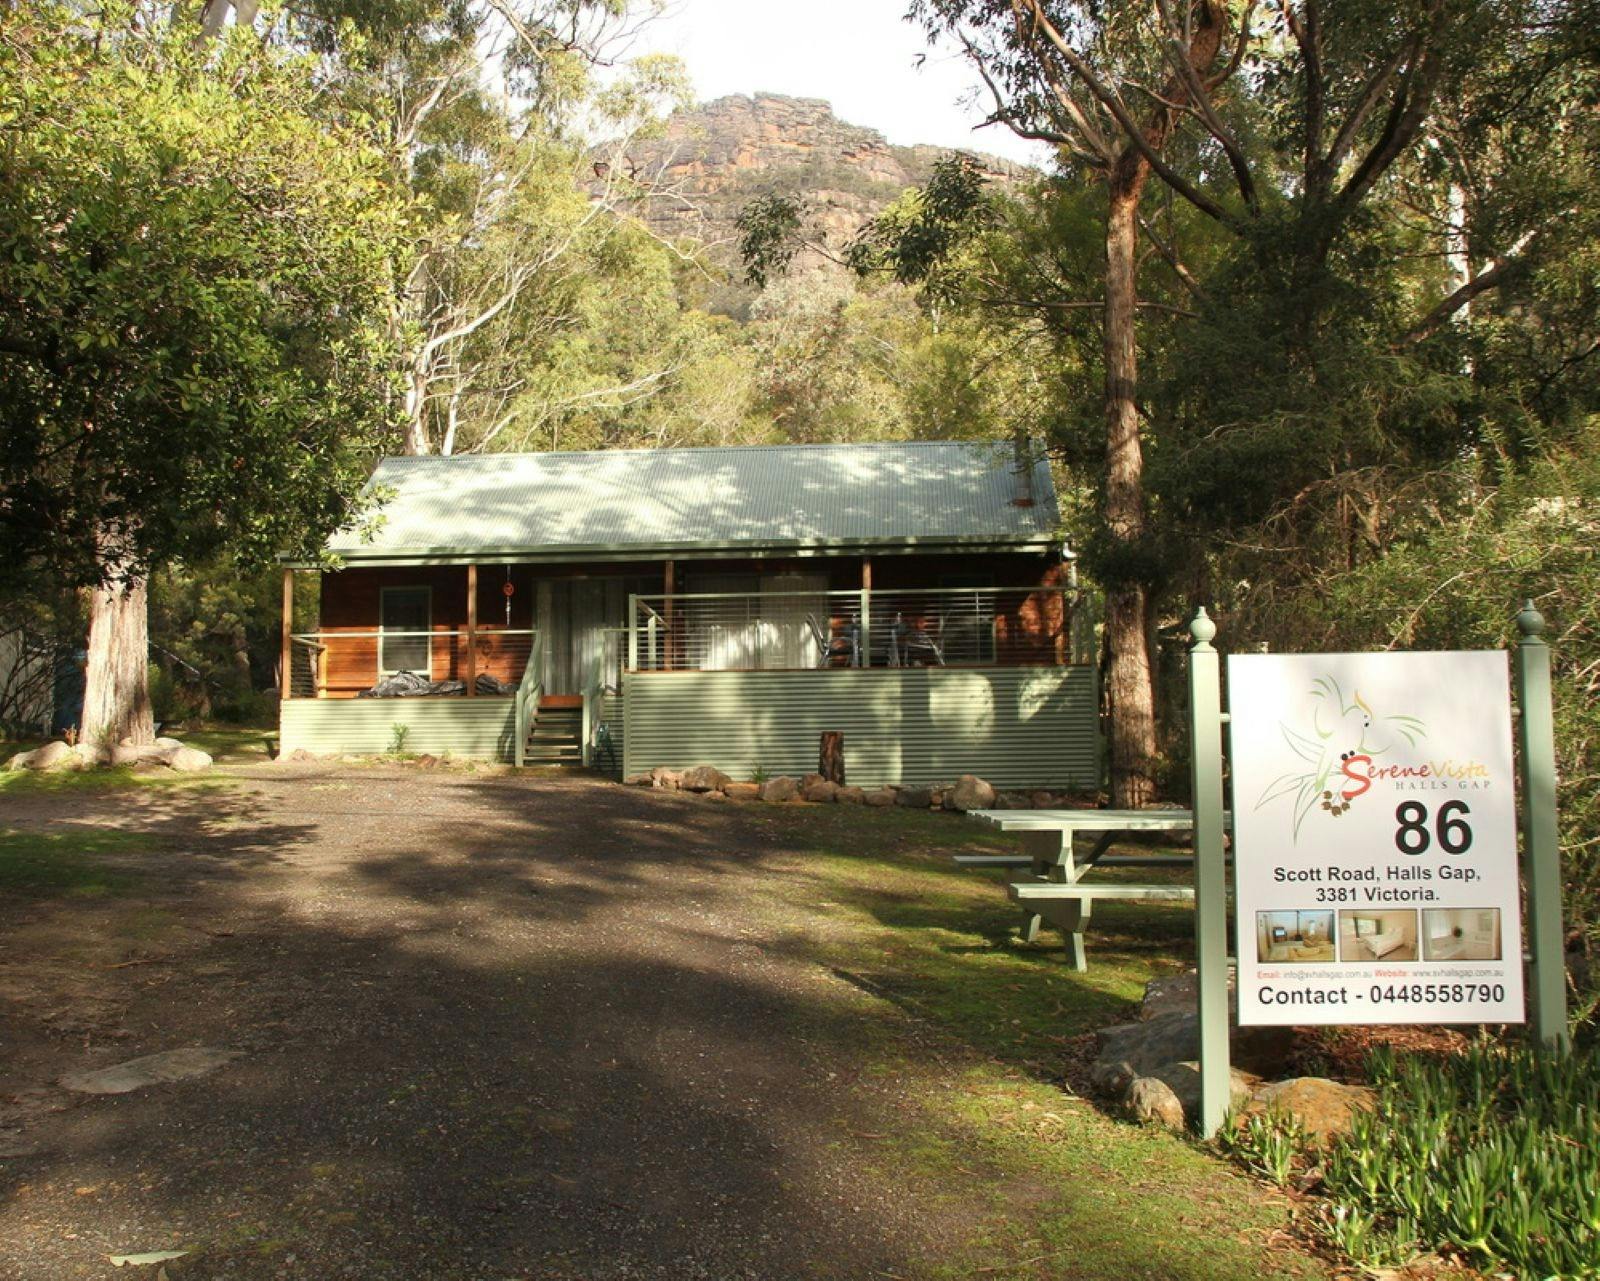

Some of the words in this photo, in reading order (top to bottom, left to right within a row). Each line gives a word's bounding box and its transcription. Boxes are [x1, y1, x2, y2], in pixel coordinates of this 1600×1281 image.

[1395, 780, 1448, 790] HALLS
[1458, 780, 1491, 790] GAP
[1395, 799, 1473, 855] 86
[1273, 866, 1321, 882] Scott
[1328, 866, 1381, 882] Road,
[1386, 866, 1432, 881] Halls
[1438, 865, 1481, 882] Gap,
[1315, 887, 1357, 902] 3381
[1364, 886, 1440, 901] Victoria.
[1258, 986, 1348, 1004] Contact
[1370, 984, 1505, 1003] 0448558790
